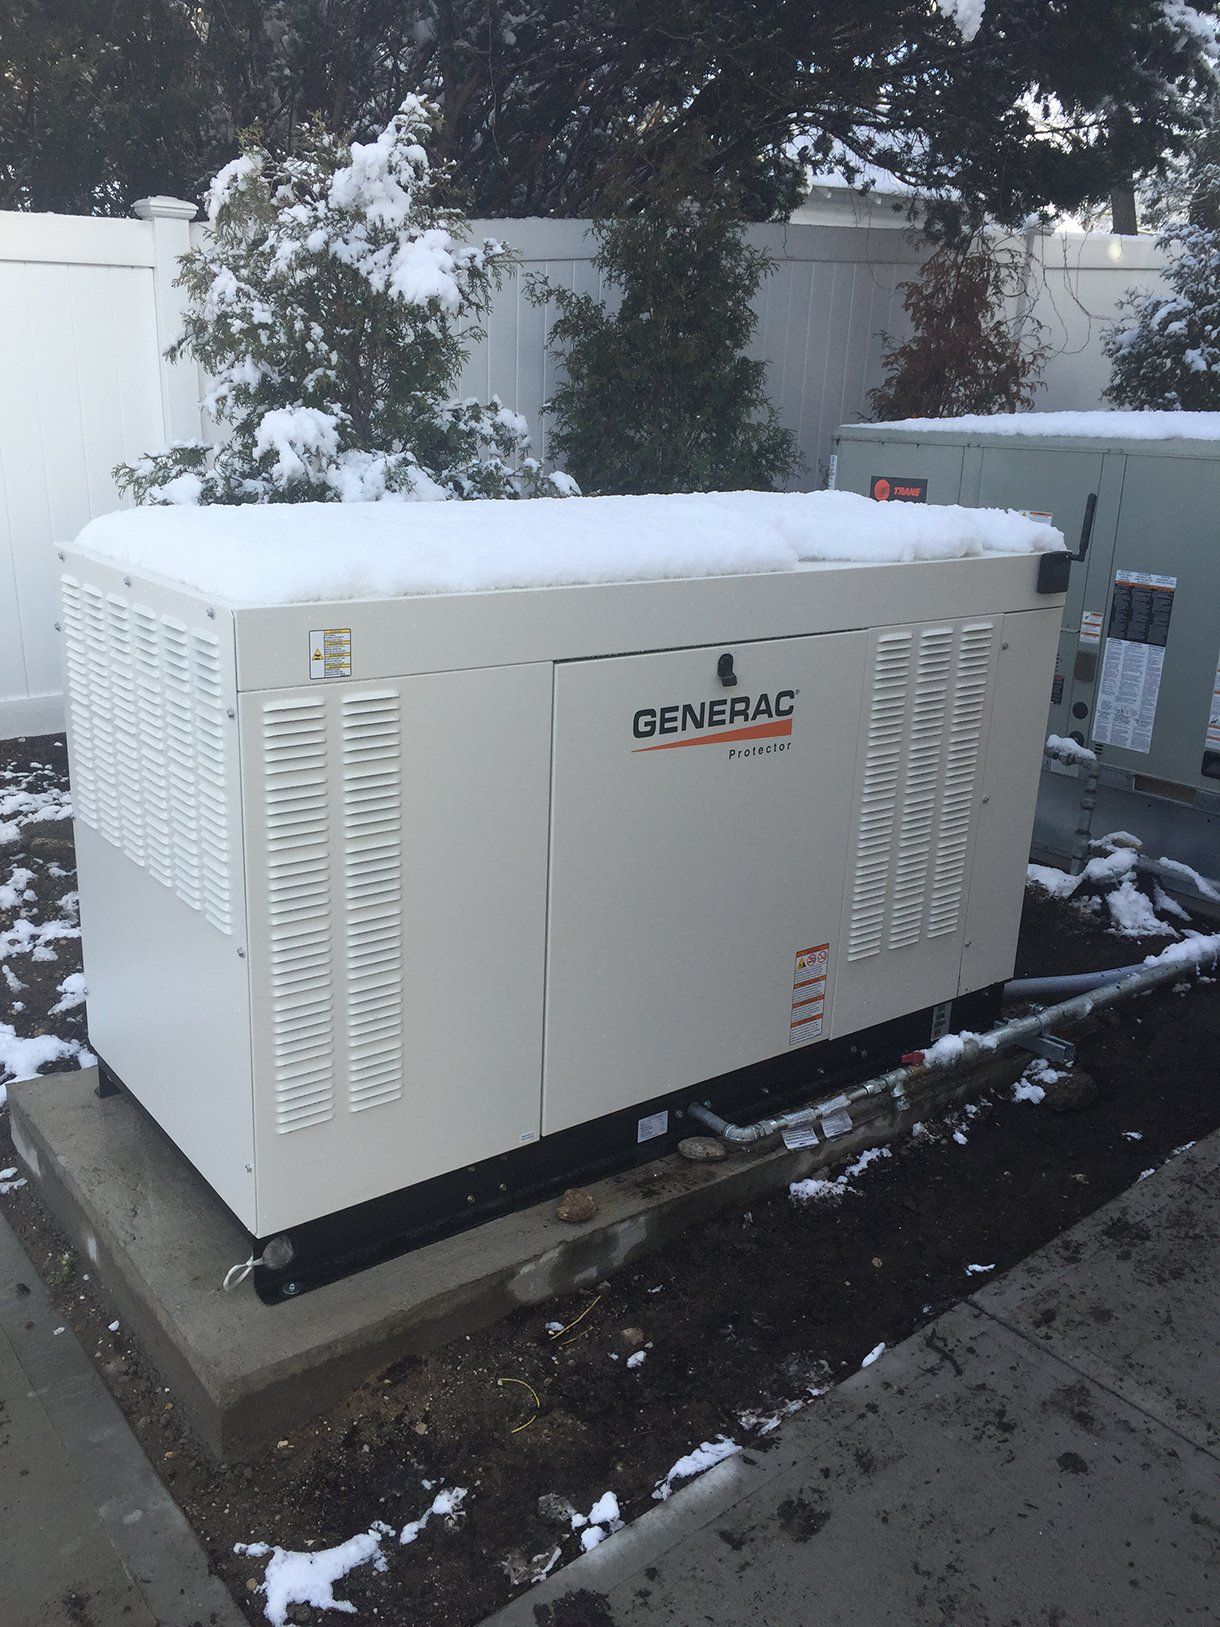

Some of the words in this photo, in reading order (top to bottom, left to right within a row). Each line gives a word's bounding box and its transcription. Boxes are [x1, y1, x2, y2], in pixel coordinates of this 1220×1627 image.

[893, 486, 921, 497] TRANE
[632, 689, 795, 739] GENERAC
[728, 741, 792, 760] Protector
